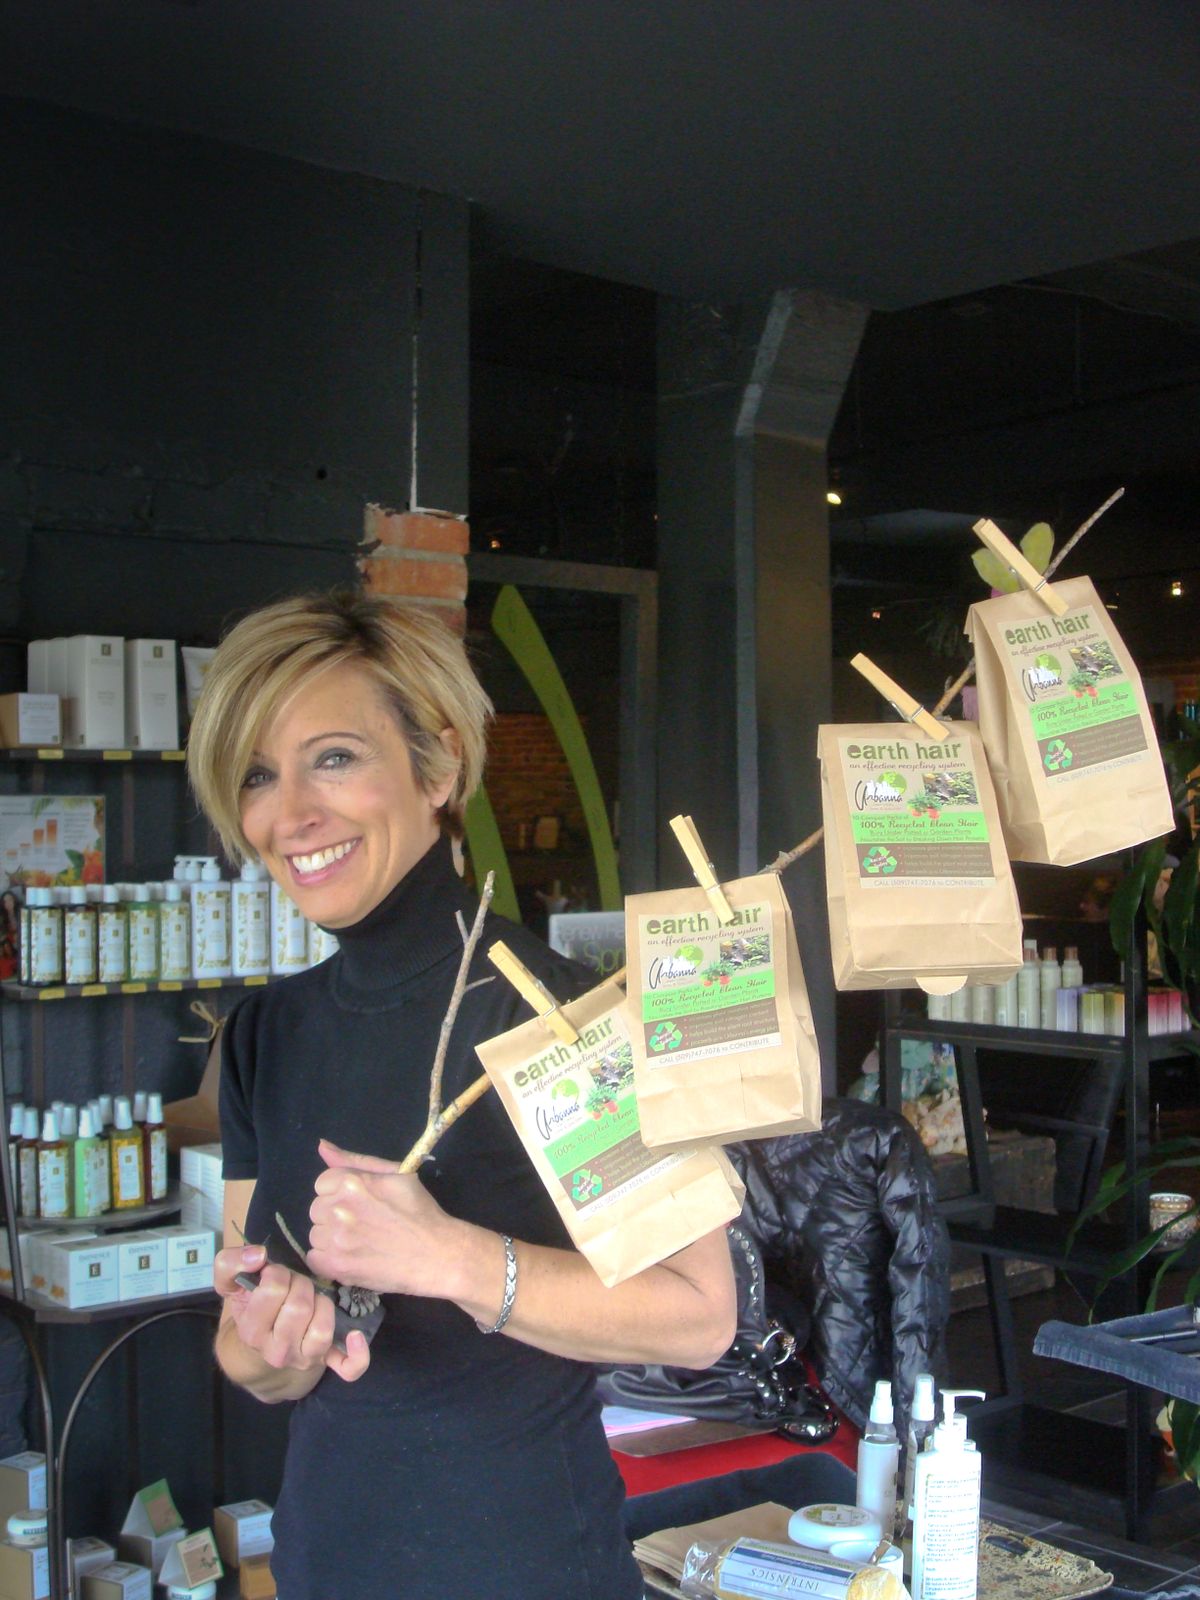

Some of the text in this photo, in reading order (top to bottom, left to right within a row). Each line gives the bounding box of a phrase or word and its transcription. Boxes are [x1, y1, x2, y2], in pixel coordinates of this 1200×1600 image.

[1005, 614, 1090, 645] earth hair
[1020, 644, 1046, 658] effective
[1046, 638, 1077, 650] recycling
[1078, 632, 1099, 641] system
[1038, 710, 1057, 722] 100%
[1059, 702, 1088, 716] Recycled
[847, 742, 961, 760] earth hair
[863, 761, 896, 771] effective
[899, 761, 935, 771] recycling
[938, 762, 965, 770] system
[888, 820, 925, 831] Recycled
[958, 819, 978, 827] Hair
[646, 914, 708, 934] earth
[661, 936, 695, 946] effective
[697, 931, 735, 942] recycling
[738, 926, 764, 935] system
[651, 998, 675, 1007] 100%
[679, 990, 715, 1002] Recycled
[747, 979, 767, 988] Hair
[514, 1045, 571, 1087] earth
[522, 1035, 623, 1099] an effective recycling system
[659, 1054, 674, 1064] CALL
[554, 1143, 576, 1160] 100%
[577, 1120, 609, 1144] Recycled
[752, 1568, 818, 1590] INTRINSICS
